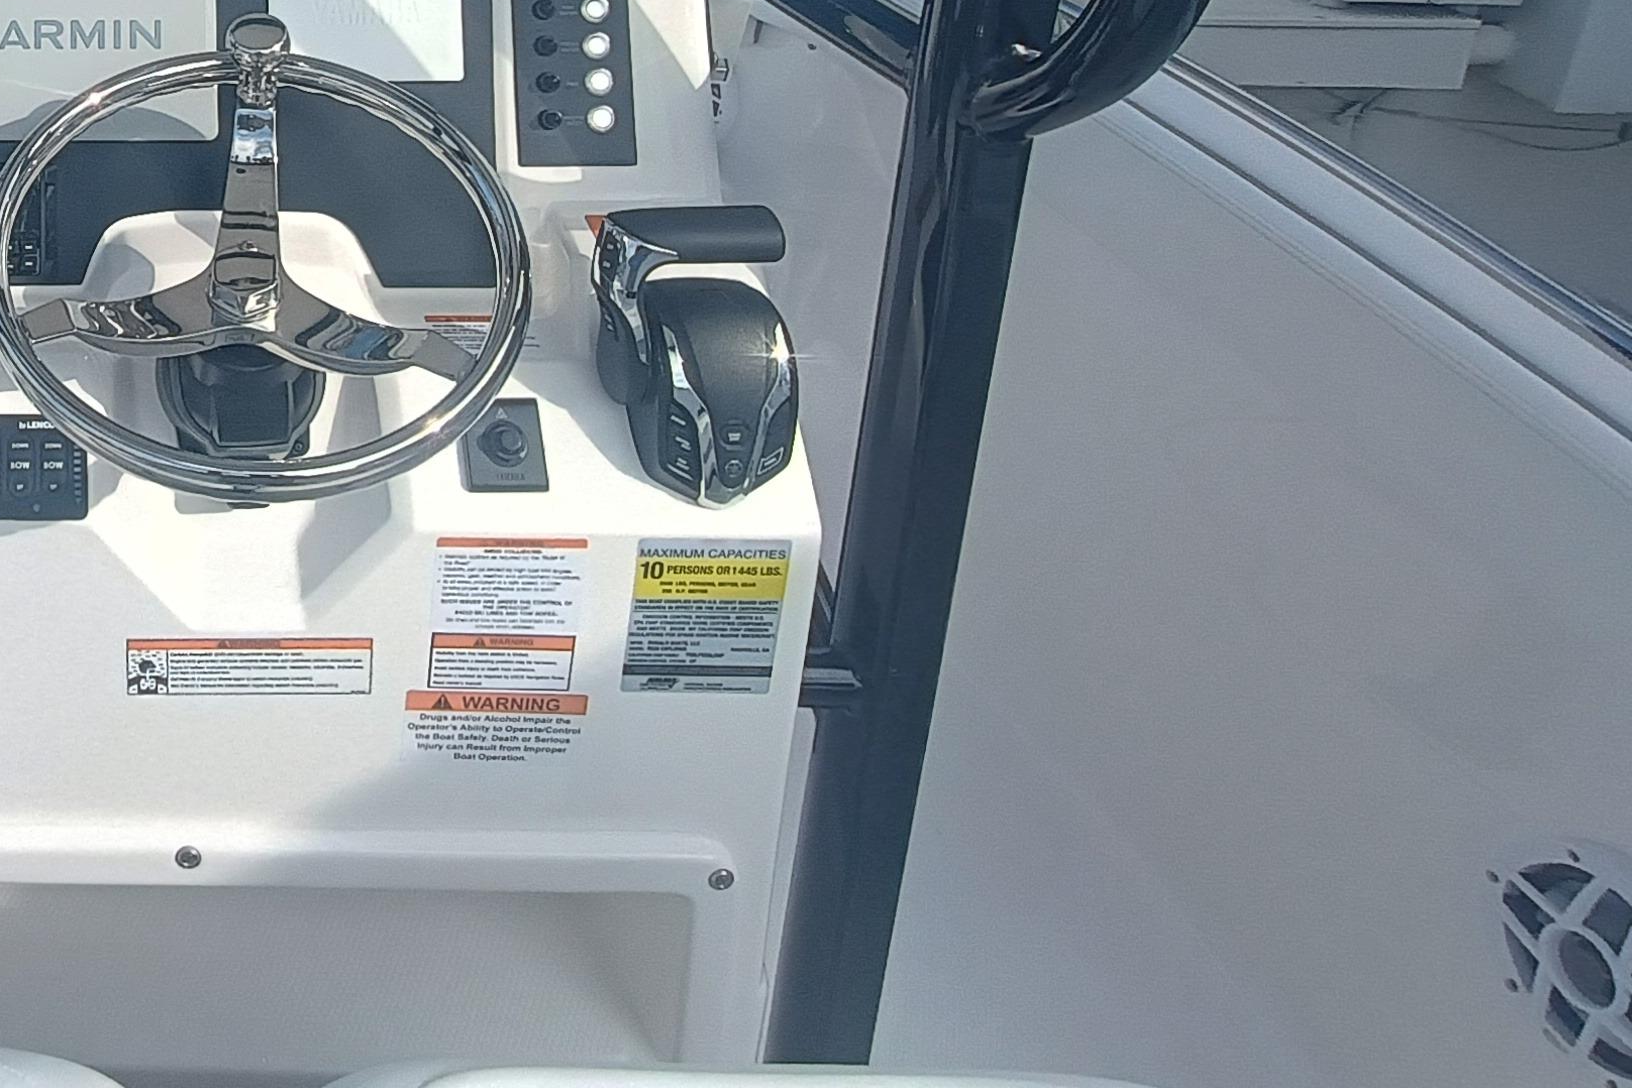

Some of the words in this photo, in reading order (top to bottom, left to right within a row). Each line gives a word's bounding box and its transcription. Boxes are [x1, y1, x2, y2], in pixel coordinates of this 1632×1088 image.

[10, 461, 30, 469] BOW
[43, 461, 63, 469] BOW
[640, 549, 704, 558] MAXIMUM
[708, 549, 786, 559] CAPACITIES
[640, 561, 664, 579] 10
[667, 565, 713, 575] PERSONS
[716, 566, 730, 575] OR
[732, 566, 758, 575] 1445
[760, 567, 783, 576] LBS.
[489, 638, 534, 646] WARNING
[463, 695, 560, 711] WARNING
[420, 713, 448, 722] Drugs
[451, 714, 481, 722] and/or
[485, 715, 520, 723] Alcohol
[523, 716, 553, 725] Impair
[407, 723, 458, 732] Operator's
[460, 724, 490, 733] Ability
[505, 726, 581, 735] Operate/Control
[433, 733, 455, 741] Boat
[491, 735, 519, 743] Death
[534, 736, 570, 744] Serious
[417, 743, 443, 752] Injury
[524, 746, 566, 755] Improper
[454, 753, 476, 761] Boat
[479, 754, 527, 762] Operation.
